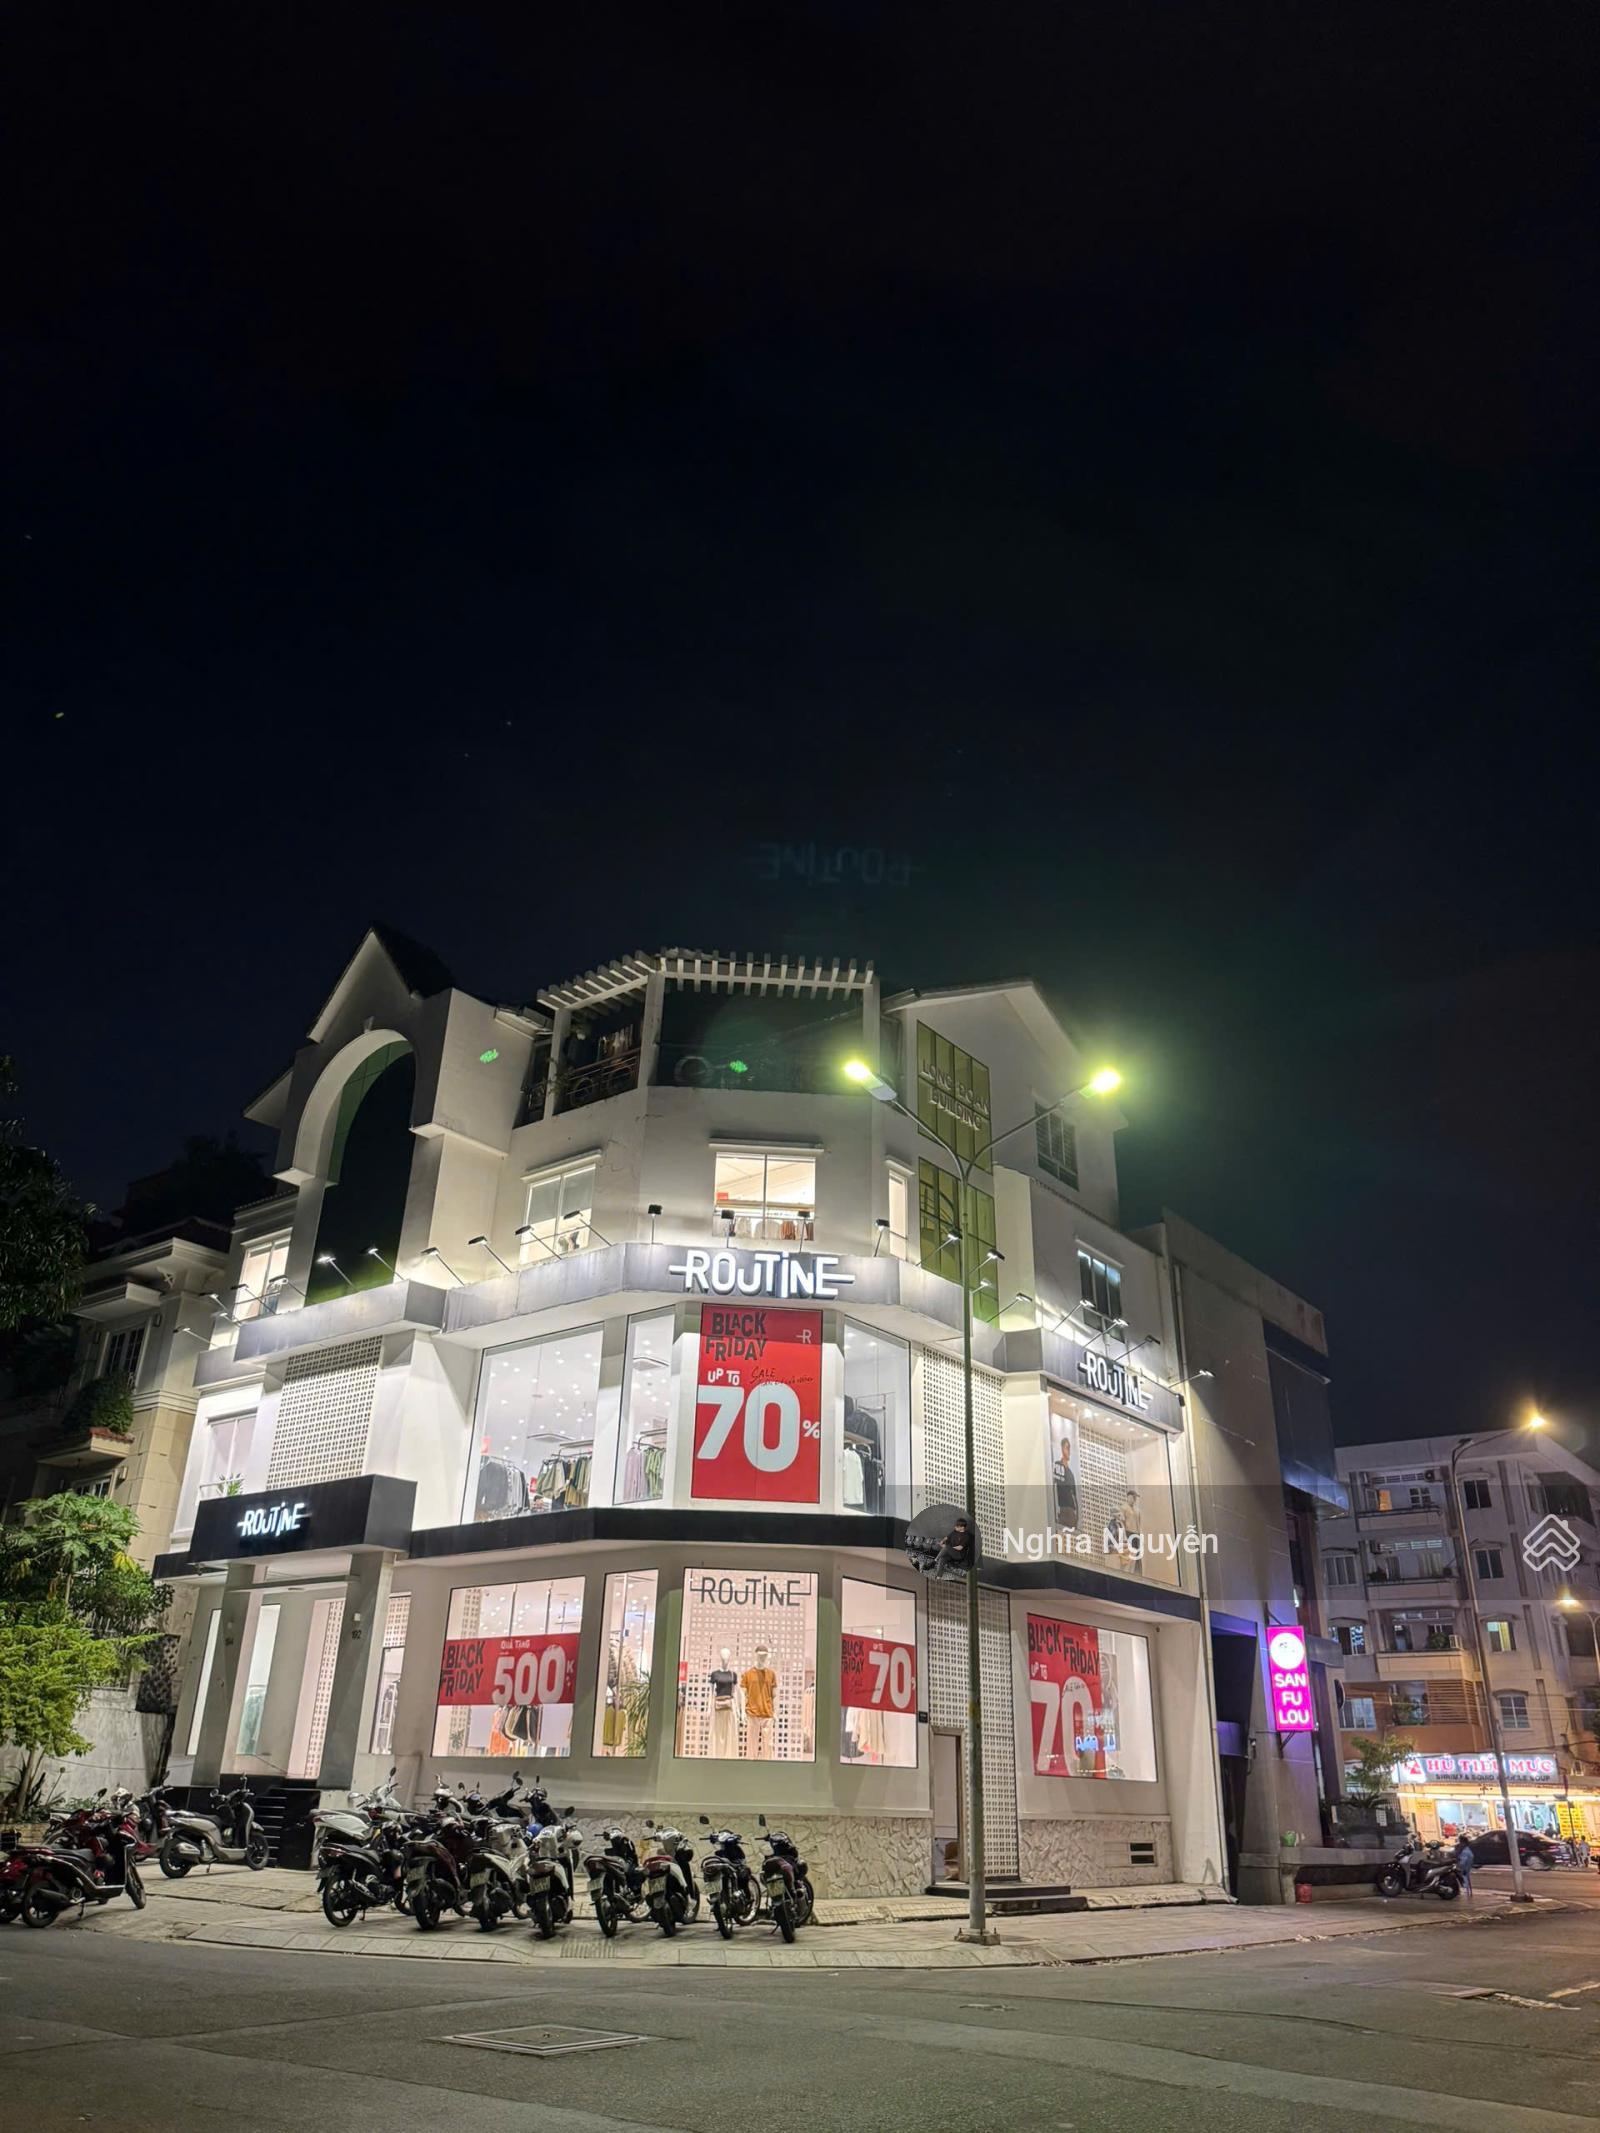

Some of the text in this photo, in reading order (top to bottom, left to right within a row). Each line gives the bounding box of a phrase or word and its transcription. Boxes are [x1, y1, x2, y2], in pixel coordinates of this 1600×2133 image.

[929, 1087, 981, 1131] BUILDING
[669, 1250, 855, 1298] ROUTINE
[711, 1312, 767, 1337] BLACK
[705, 1335, 767, 1361] FRIDAY
[707, 1368, 740, 1385] UP TO
[1079, 1351, 1153, 1410] ROUTINE
[237, 1502, 312, 1537] ROUTINE
[699, 1576, 801, 1609] ROUTINE
[446, 1641, 485, 1669] BLACK
[842, 1639, 864, 1657] BLACK
[1028, 1623, 1100, 1676] BLACK FRIDAY
[842, 1656, 864, 1674] FRIDAY
[440, 1669, 483, 1697] FRIDAY
[1274, 1673, 1306, 1688] SAN
[1282, 1691, 1303, 1706] FU
[1030, 1676, 1094, 1777] 70
[1279, 1709, 1310, 1724] LOU
